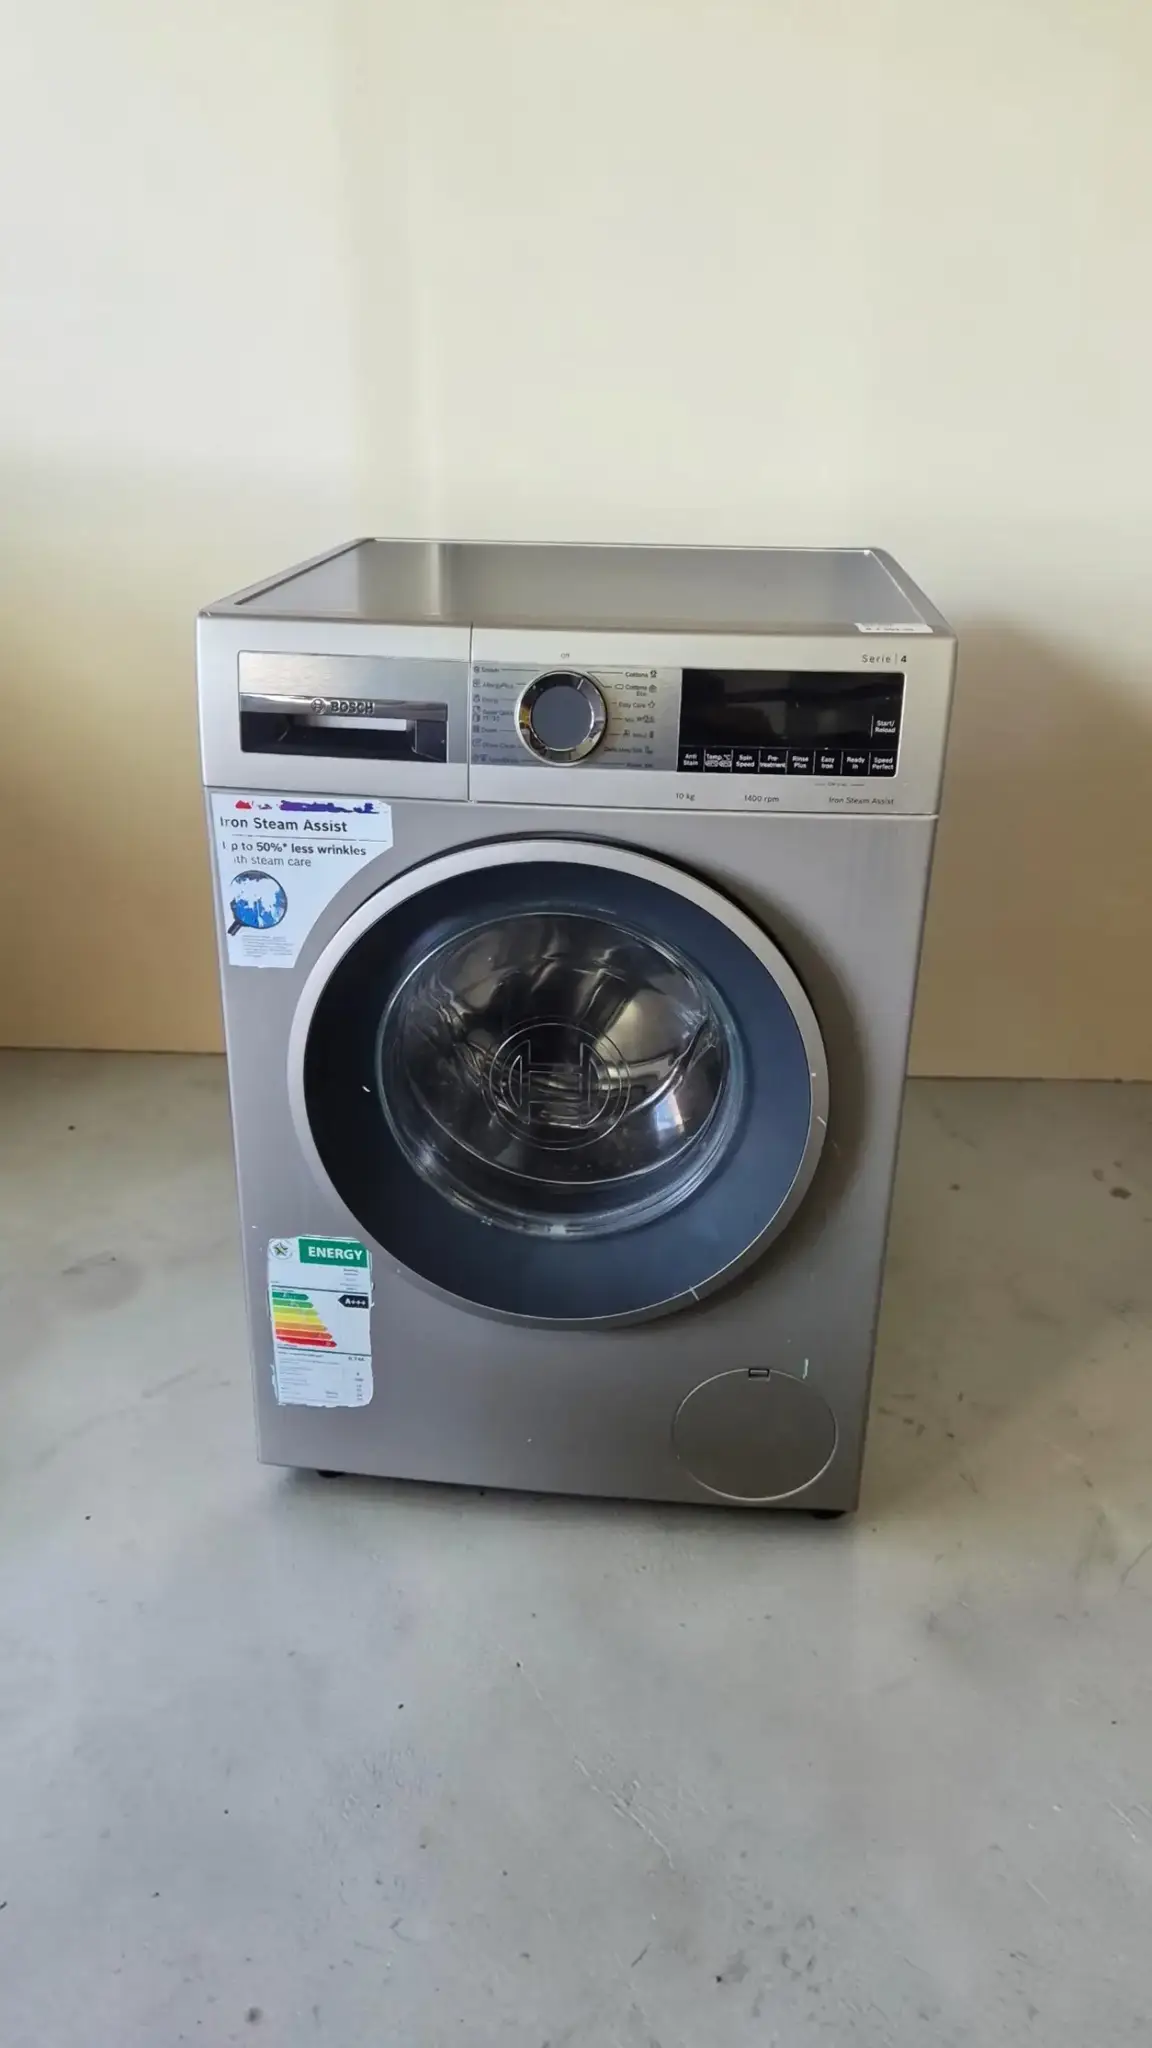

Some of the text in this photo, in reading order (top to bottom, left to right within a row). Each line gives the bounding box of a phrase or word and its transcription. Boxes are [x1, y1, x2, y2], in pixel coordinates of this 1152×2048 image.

[862, 654, 907, 664] Serie 4
[330, 700, 375, 716] BOSCH
[876, 720, 896, 728] Start/
[739, 754, 753, 762] Spin
[821, 756, 835, 764] Easy
[846, 756, 866, 764] Ready
[874, 757, 894, 765] Speed
[686, 793, 695, 801] kg
[220, 816, 348, 832] Iron Steam Assist
[241, 841, 253, 851] to
[291, 843, 314, 854] less
[317, 844, 367, 856] wrinkles
[251, 857, 284, 867] steam
[287, 859, 312, 867] care
[308, 1246, 363, 1261] ENERGY
[345, 1298, 366, 1306] A+++
